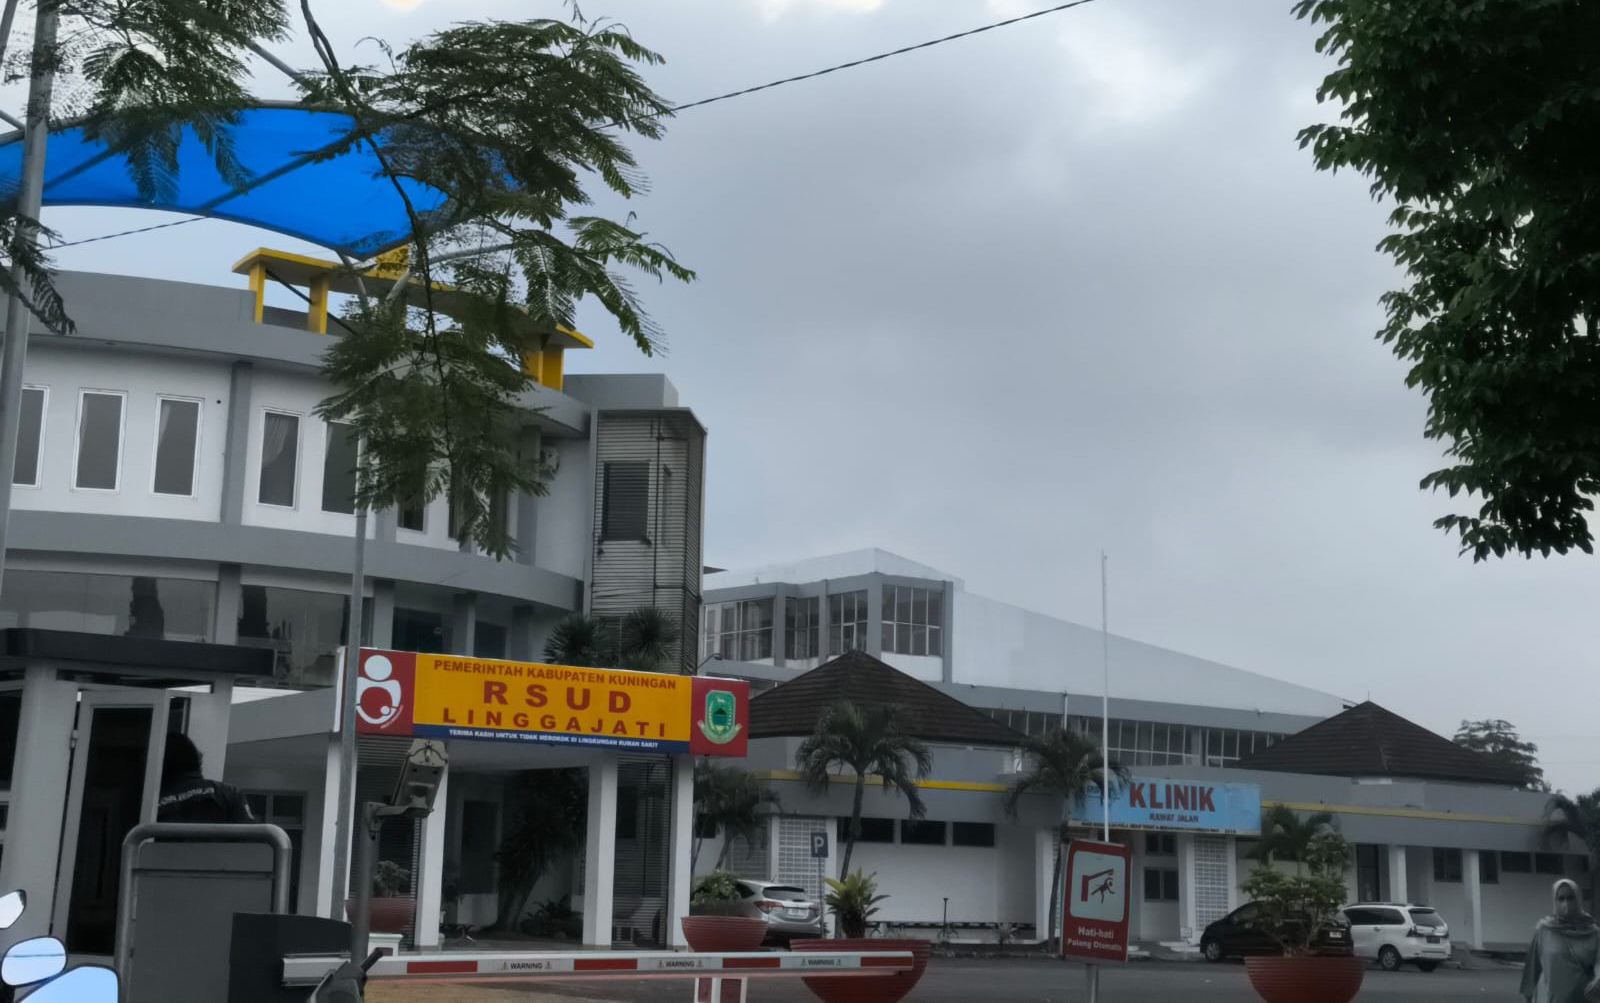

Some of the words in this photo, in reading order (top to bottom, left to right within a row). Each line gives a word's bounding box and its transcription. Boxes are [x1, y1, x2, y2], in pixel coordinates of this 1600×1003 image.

[434, 660, 523, 677] PEMERINTAH
[527, 667, 605, 684] KABUPATEN
[609, 674, 676, 690] KUNINGAN
[483, 680, 631, 714] RSUD
[443, 708, 665, 737] LINGGAJATI
[449, 729, 473, 737] TERIMA
[475, 730, 494, 738] KASIH
[1129, 782, 1216, 812] KLINIK
[1149, 812, 1175, 822] RAWAT
[1177, 814, 1199, 823] JALAN
[814, 836, 825, 854] P
[1078, 926, 1114, 939] Hati-hati
[1067, 938, 1092, 950] Palang
[510, 962, 542, 970] WARNING
[665, 960, 695, 968] WARNING
[808, 958, 835, 966] WARNING
